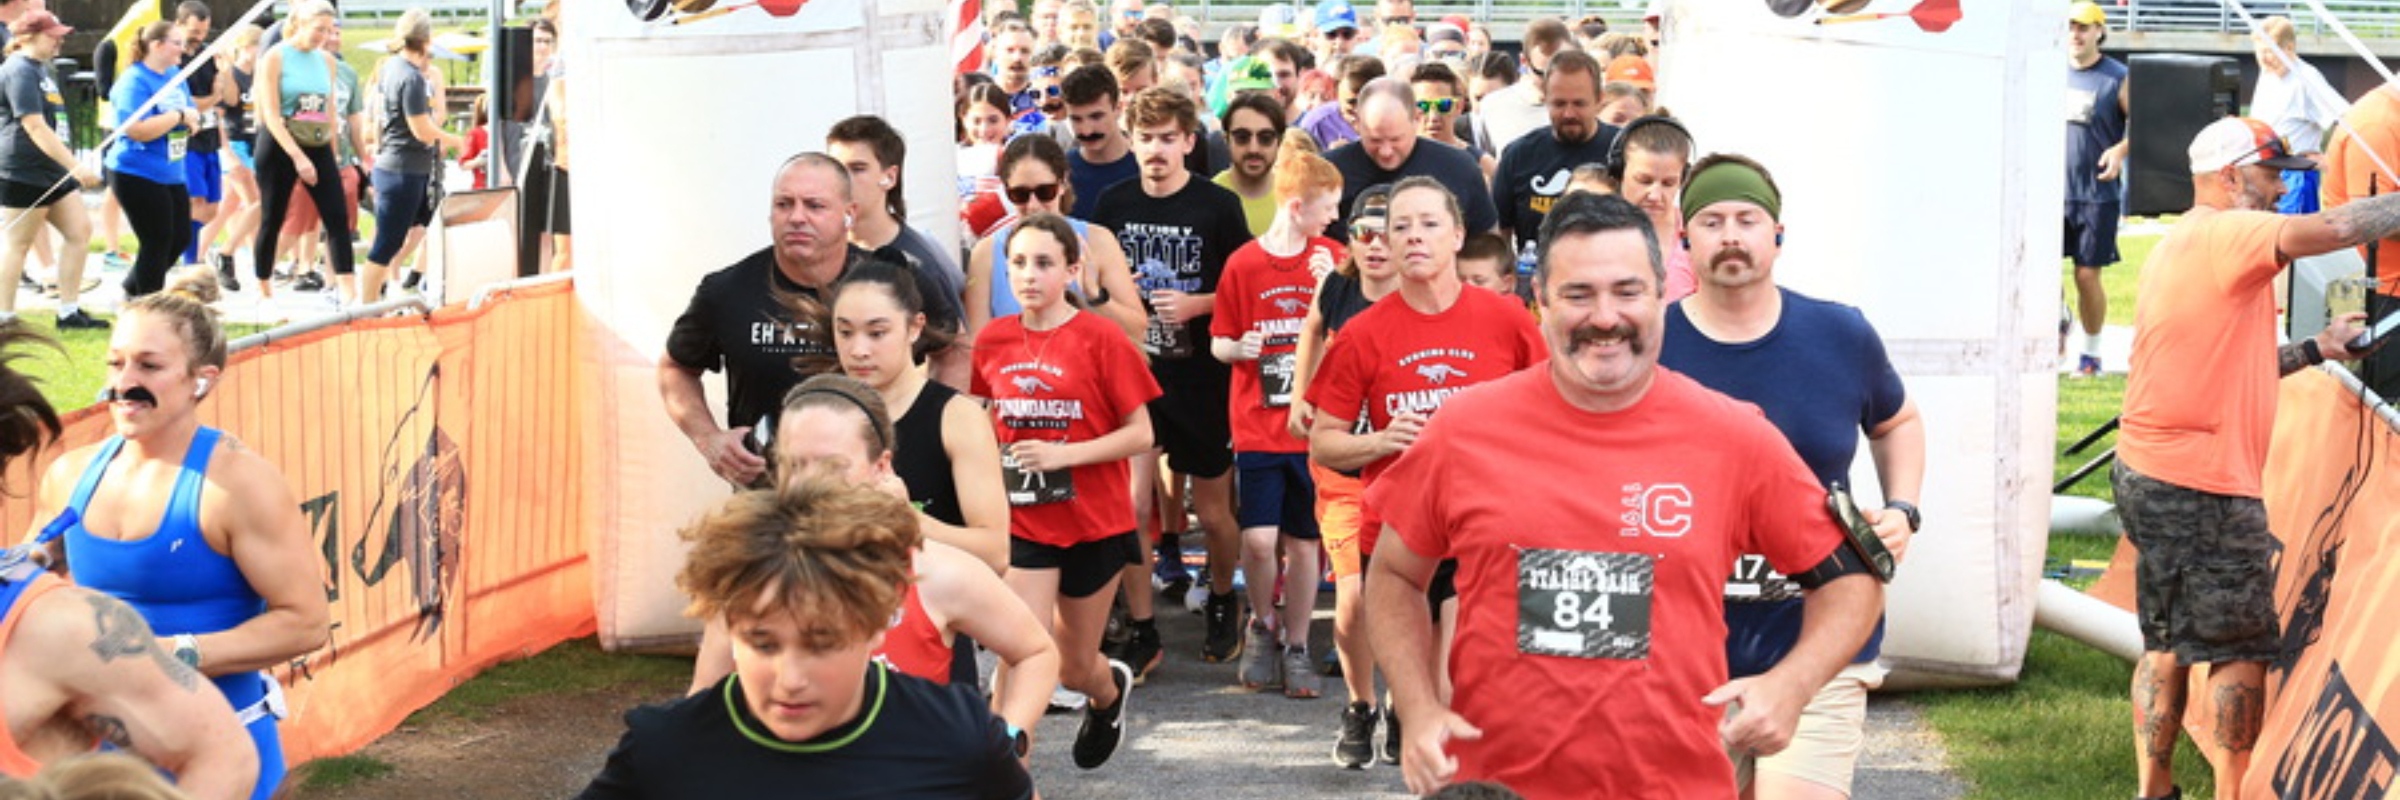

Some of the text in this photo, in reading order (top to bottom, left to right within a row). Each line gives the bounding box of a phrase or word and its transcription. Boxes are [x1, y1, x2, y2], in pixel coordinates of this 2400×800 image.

[1117, 228, 1204, 273] STATE
[1398, 348, 1476, 367] RUNNING CLUB
[1641, 482, 1693, 539] C
[1553, 590, 1614, 631] 84
